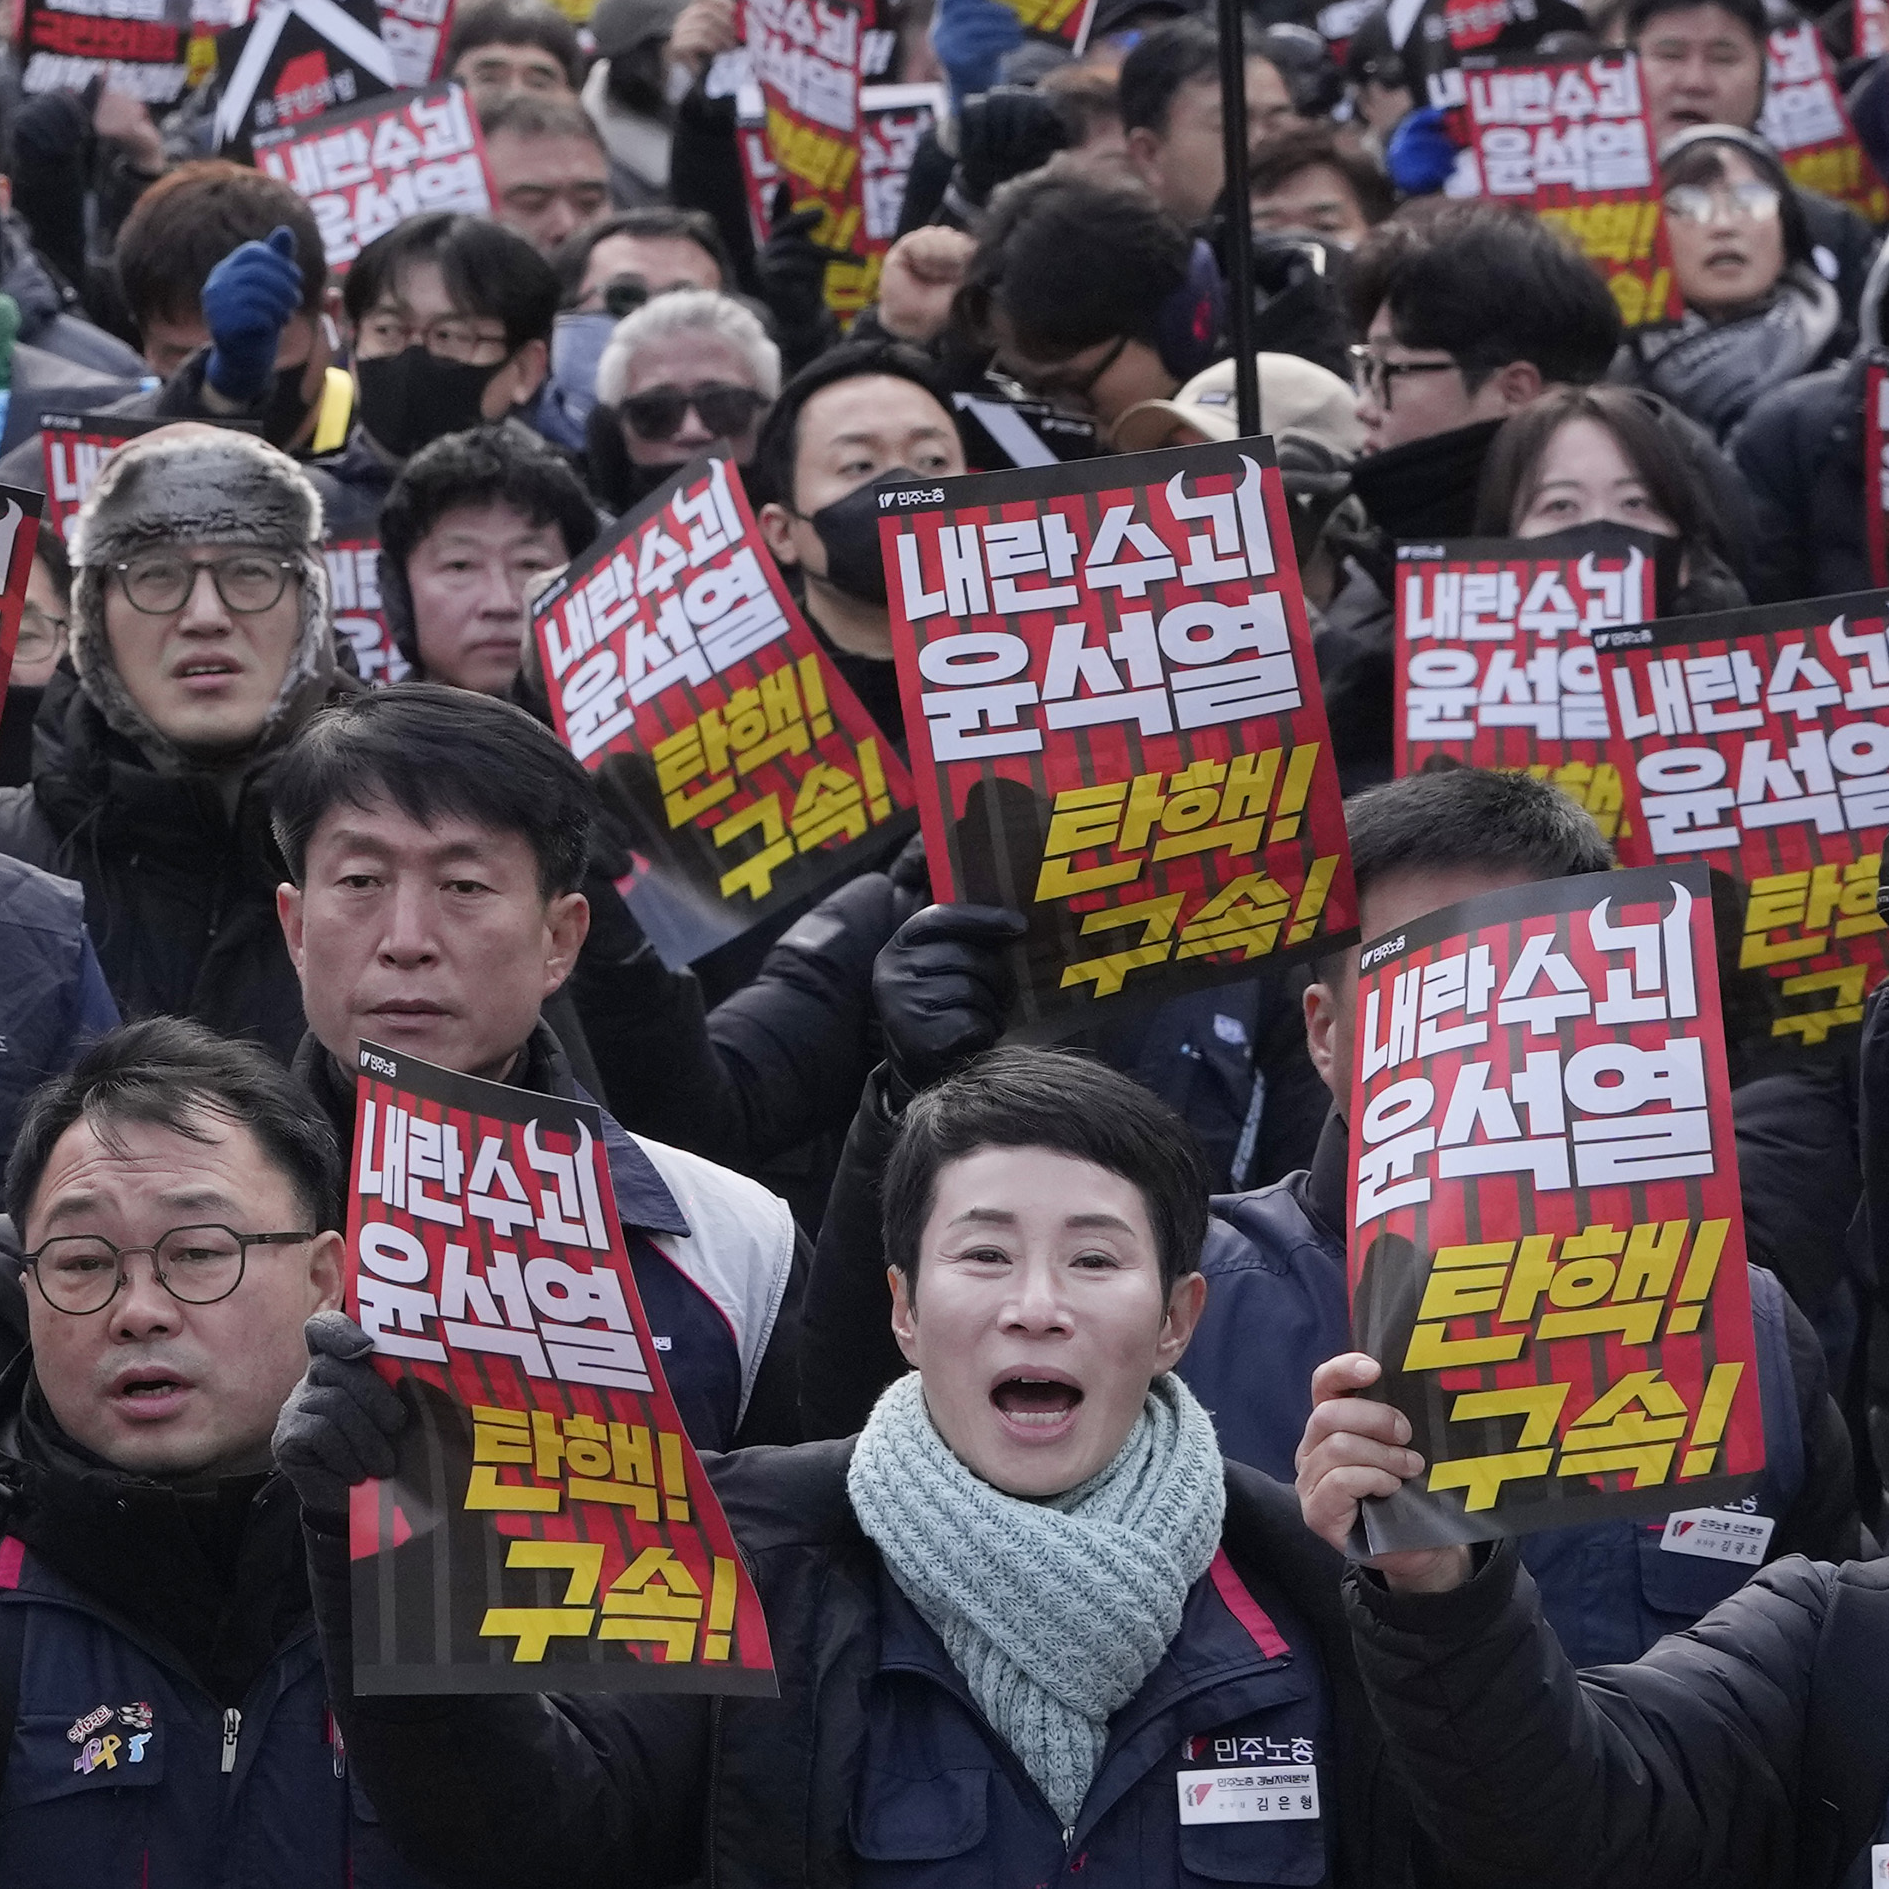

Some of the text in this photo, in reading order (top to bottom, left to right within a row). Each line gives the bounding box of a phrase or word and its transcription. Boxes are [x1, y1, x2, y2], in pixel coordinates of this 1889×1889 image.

[263, 85, 473, 191] 내란수괴
[1470, 51, 1640, 128] 내란수괴
[1480, 119, 1651, 196] 윤석열
[542, 456, 746, 680] 내란수괴
[896, 453, 1277, 623] 내란수괴
[897, 487, 946, 509] 민주노총
[561, 545, 792, 762] 윤석열
[1403, 546, 1644, 643] 내란수괴
[651, 651, 835, 831] 탄핵!
[917, 591, 1304, 764] 윤석열
[711, 737, 893, 904] 구속!
[1032, 739, 1320, 905] 탄핵!
[1059, 853, 1342, 1001] 구속!
[1362, 880, 1699, 1084] 내란수괴
[358, 1097, 610, 1251] 내란수괴
[1354, 1036, 1714, 1230] 윤석열
[357, 1222, 655, 1394] 윤석열
[1402, 1217, 1732, 1373] 탄핵!
[464, 1404, 690, 1524] 탄핵!
[1428, 1361, 1744, 1513] 구속!
[479, 1540, 738, 1663] 구속!
[1214, 1735, 1315, 1764] 민주노총
